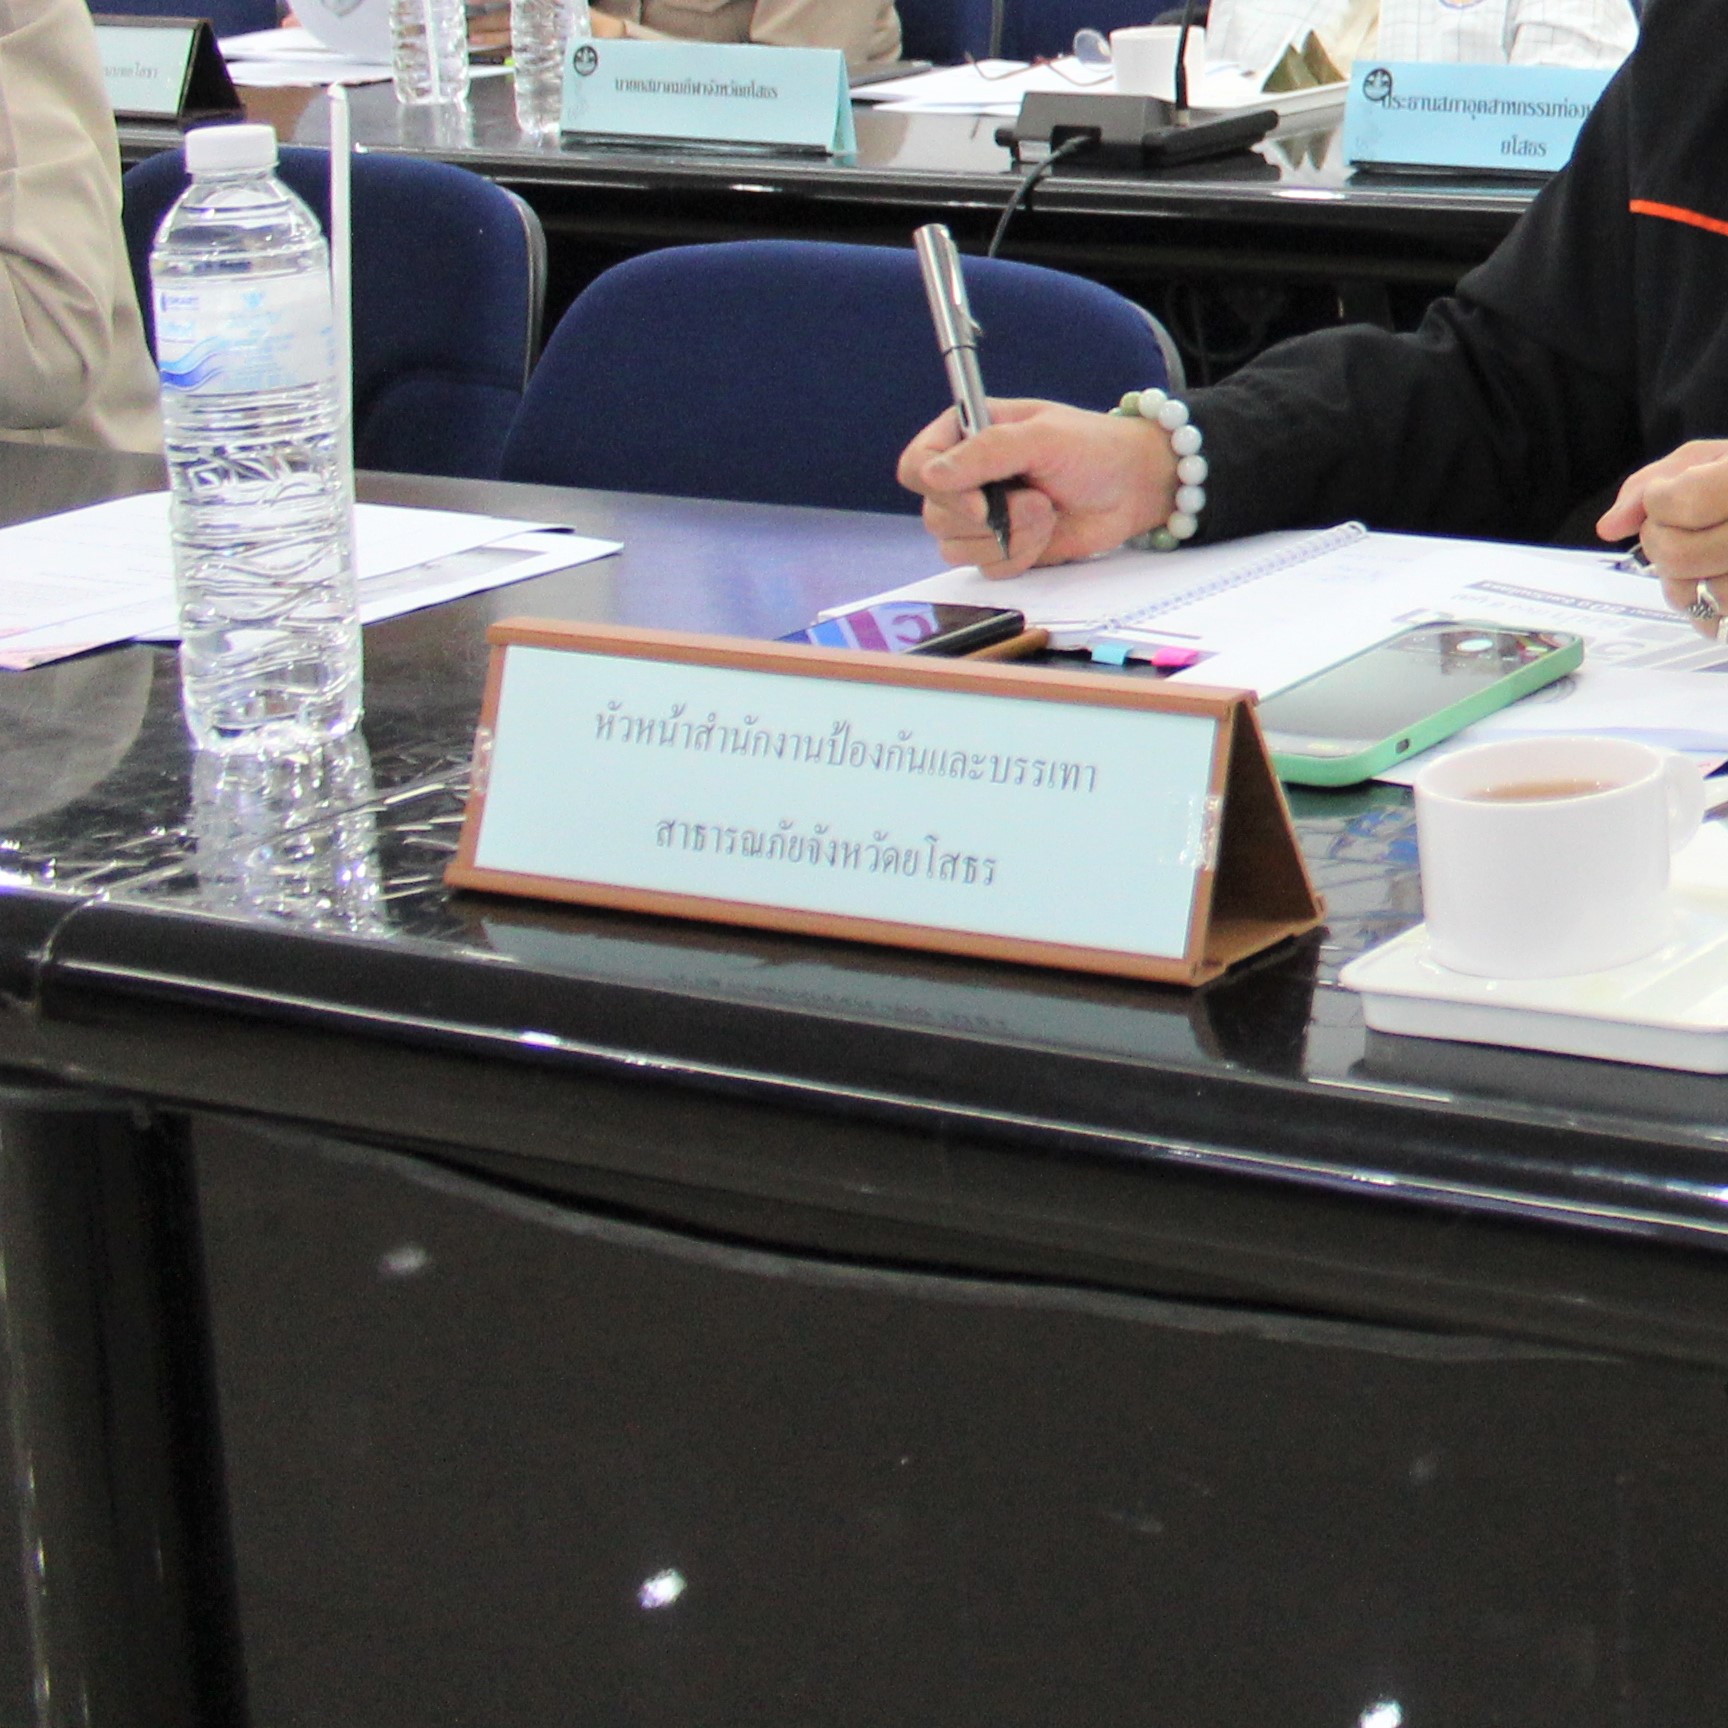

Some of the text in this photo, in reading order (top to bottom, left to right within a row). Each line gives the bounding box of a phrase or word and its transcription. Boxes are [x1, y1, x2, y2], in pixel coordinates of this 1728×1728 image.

[1500, 134, 1547, 158] ยโสธร
[594, 702, 1097, 795] หัวหน้าสำนักงานป้องกันและบรรเทา
[655, 816, 997, 888] สาธารณภัยจังหวัดยโสธร
